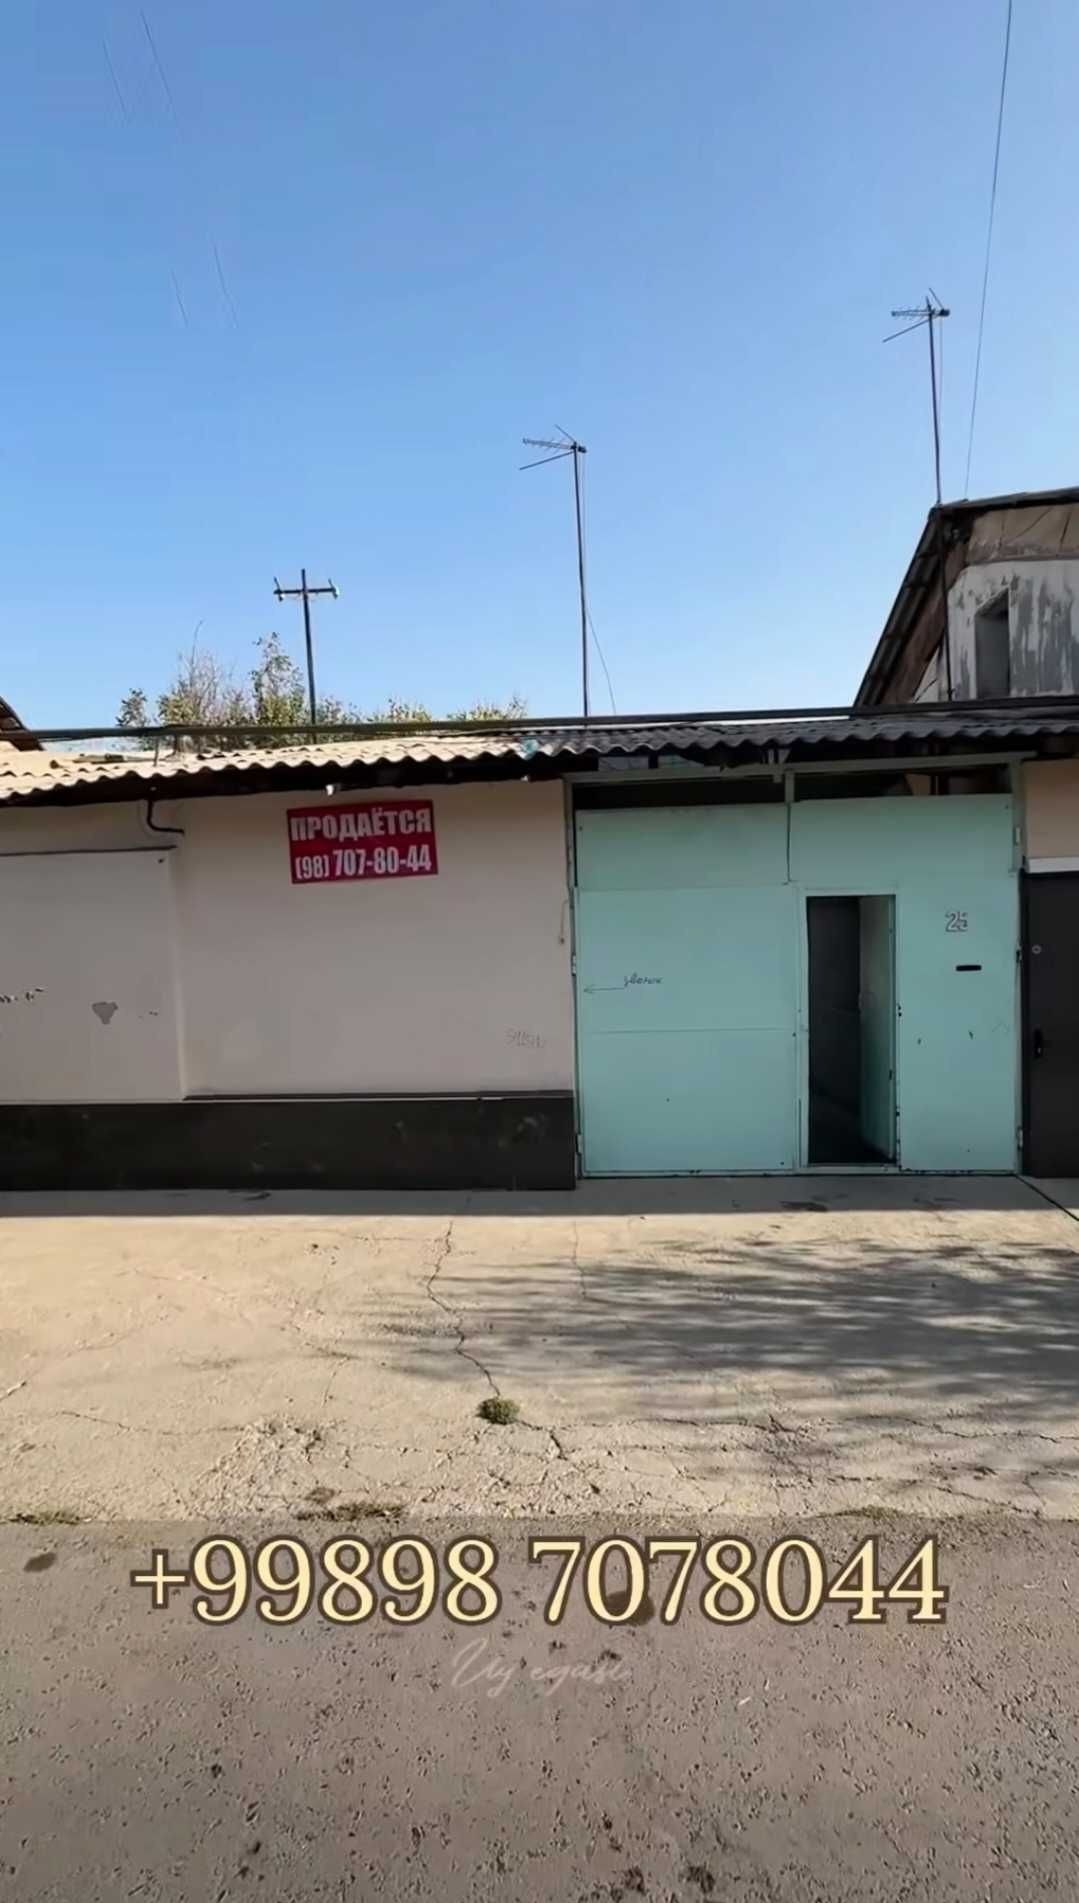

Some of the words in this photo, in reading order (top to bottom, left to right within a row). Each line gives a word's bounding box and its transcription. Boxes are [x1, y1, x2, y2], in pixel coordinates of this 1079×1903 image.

[290, 808, 432, 842] ПРОДАЁТСЯ
[295, 855, 330, 879] (98)
[333, 844, 432, 876] 707-80-44
